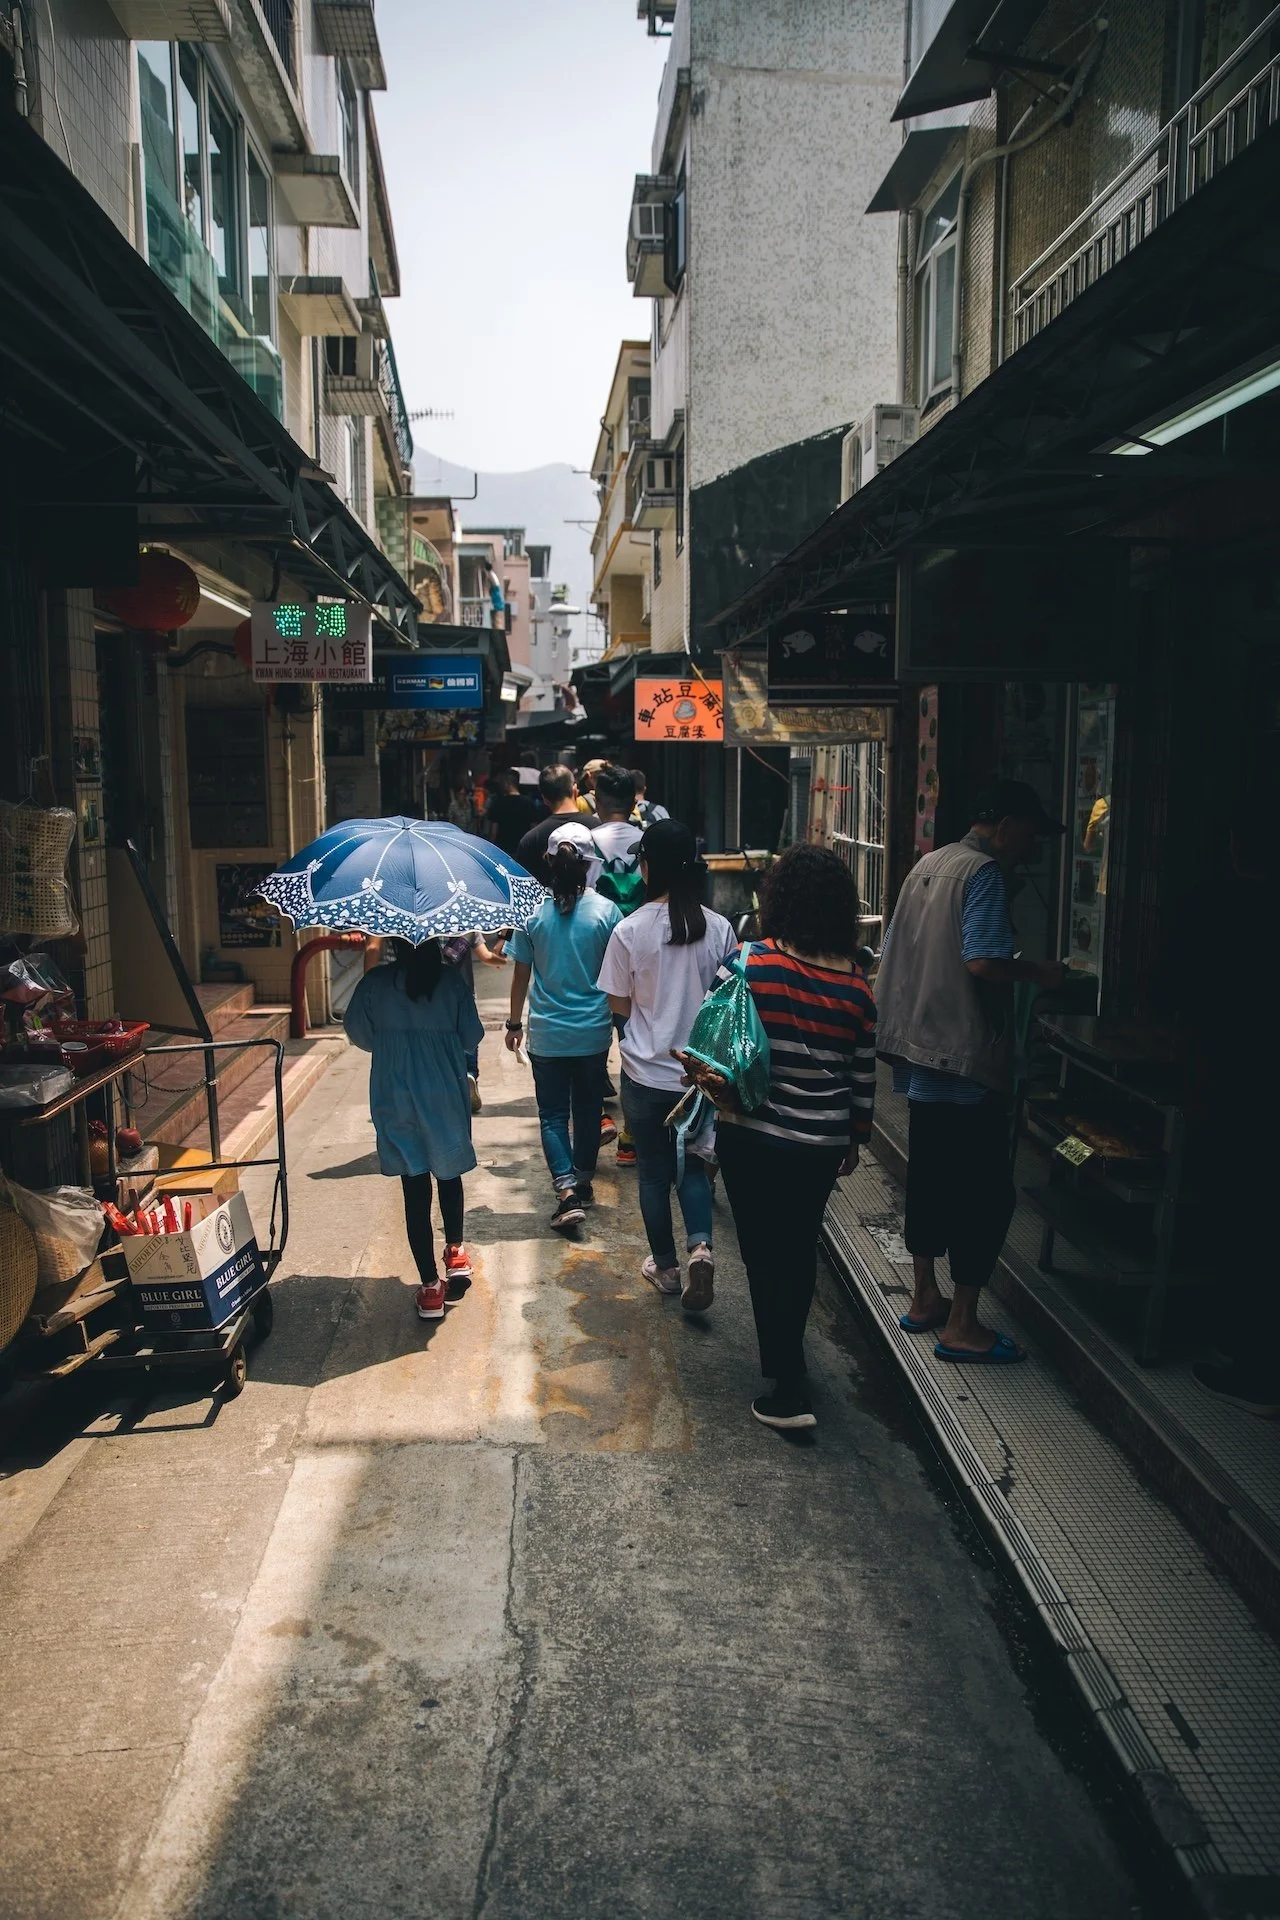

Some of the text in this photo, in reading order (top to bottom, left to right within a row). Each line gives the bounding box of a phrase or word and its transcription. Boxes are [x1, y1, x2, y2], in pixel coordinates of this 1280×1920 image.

[255, 639, 366, 666] 上海小館
[255, 668, 366, 678] KWAN HUNG SHANG HAI RESTAURANT
[128, 1236, 163, 1273] IMPORTED
[216, 1251, 253, 1290] BLUE GIRL
[141, 1289, 202, 1303] BLUE GIRL
